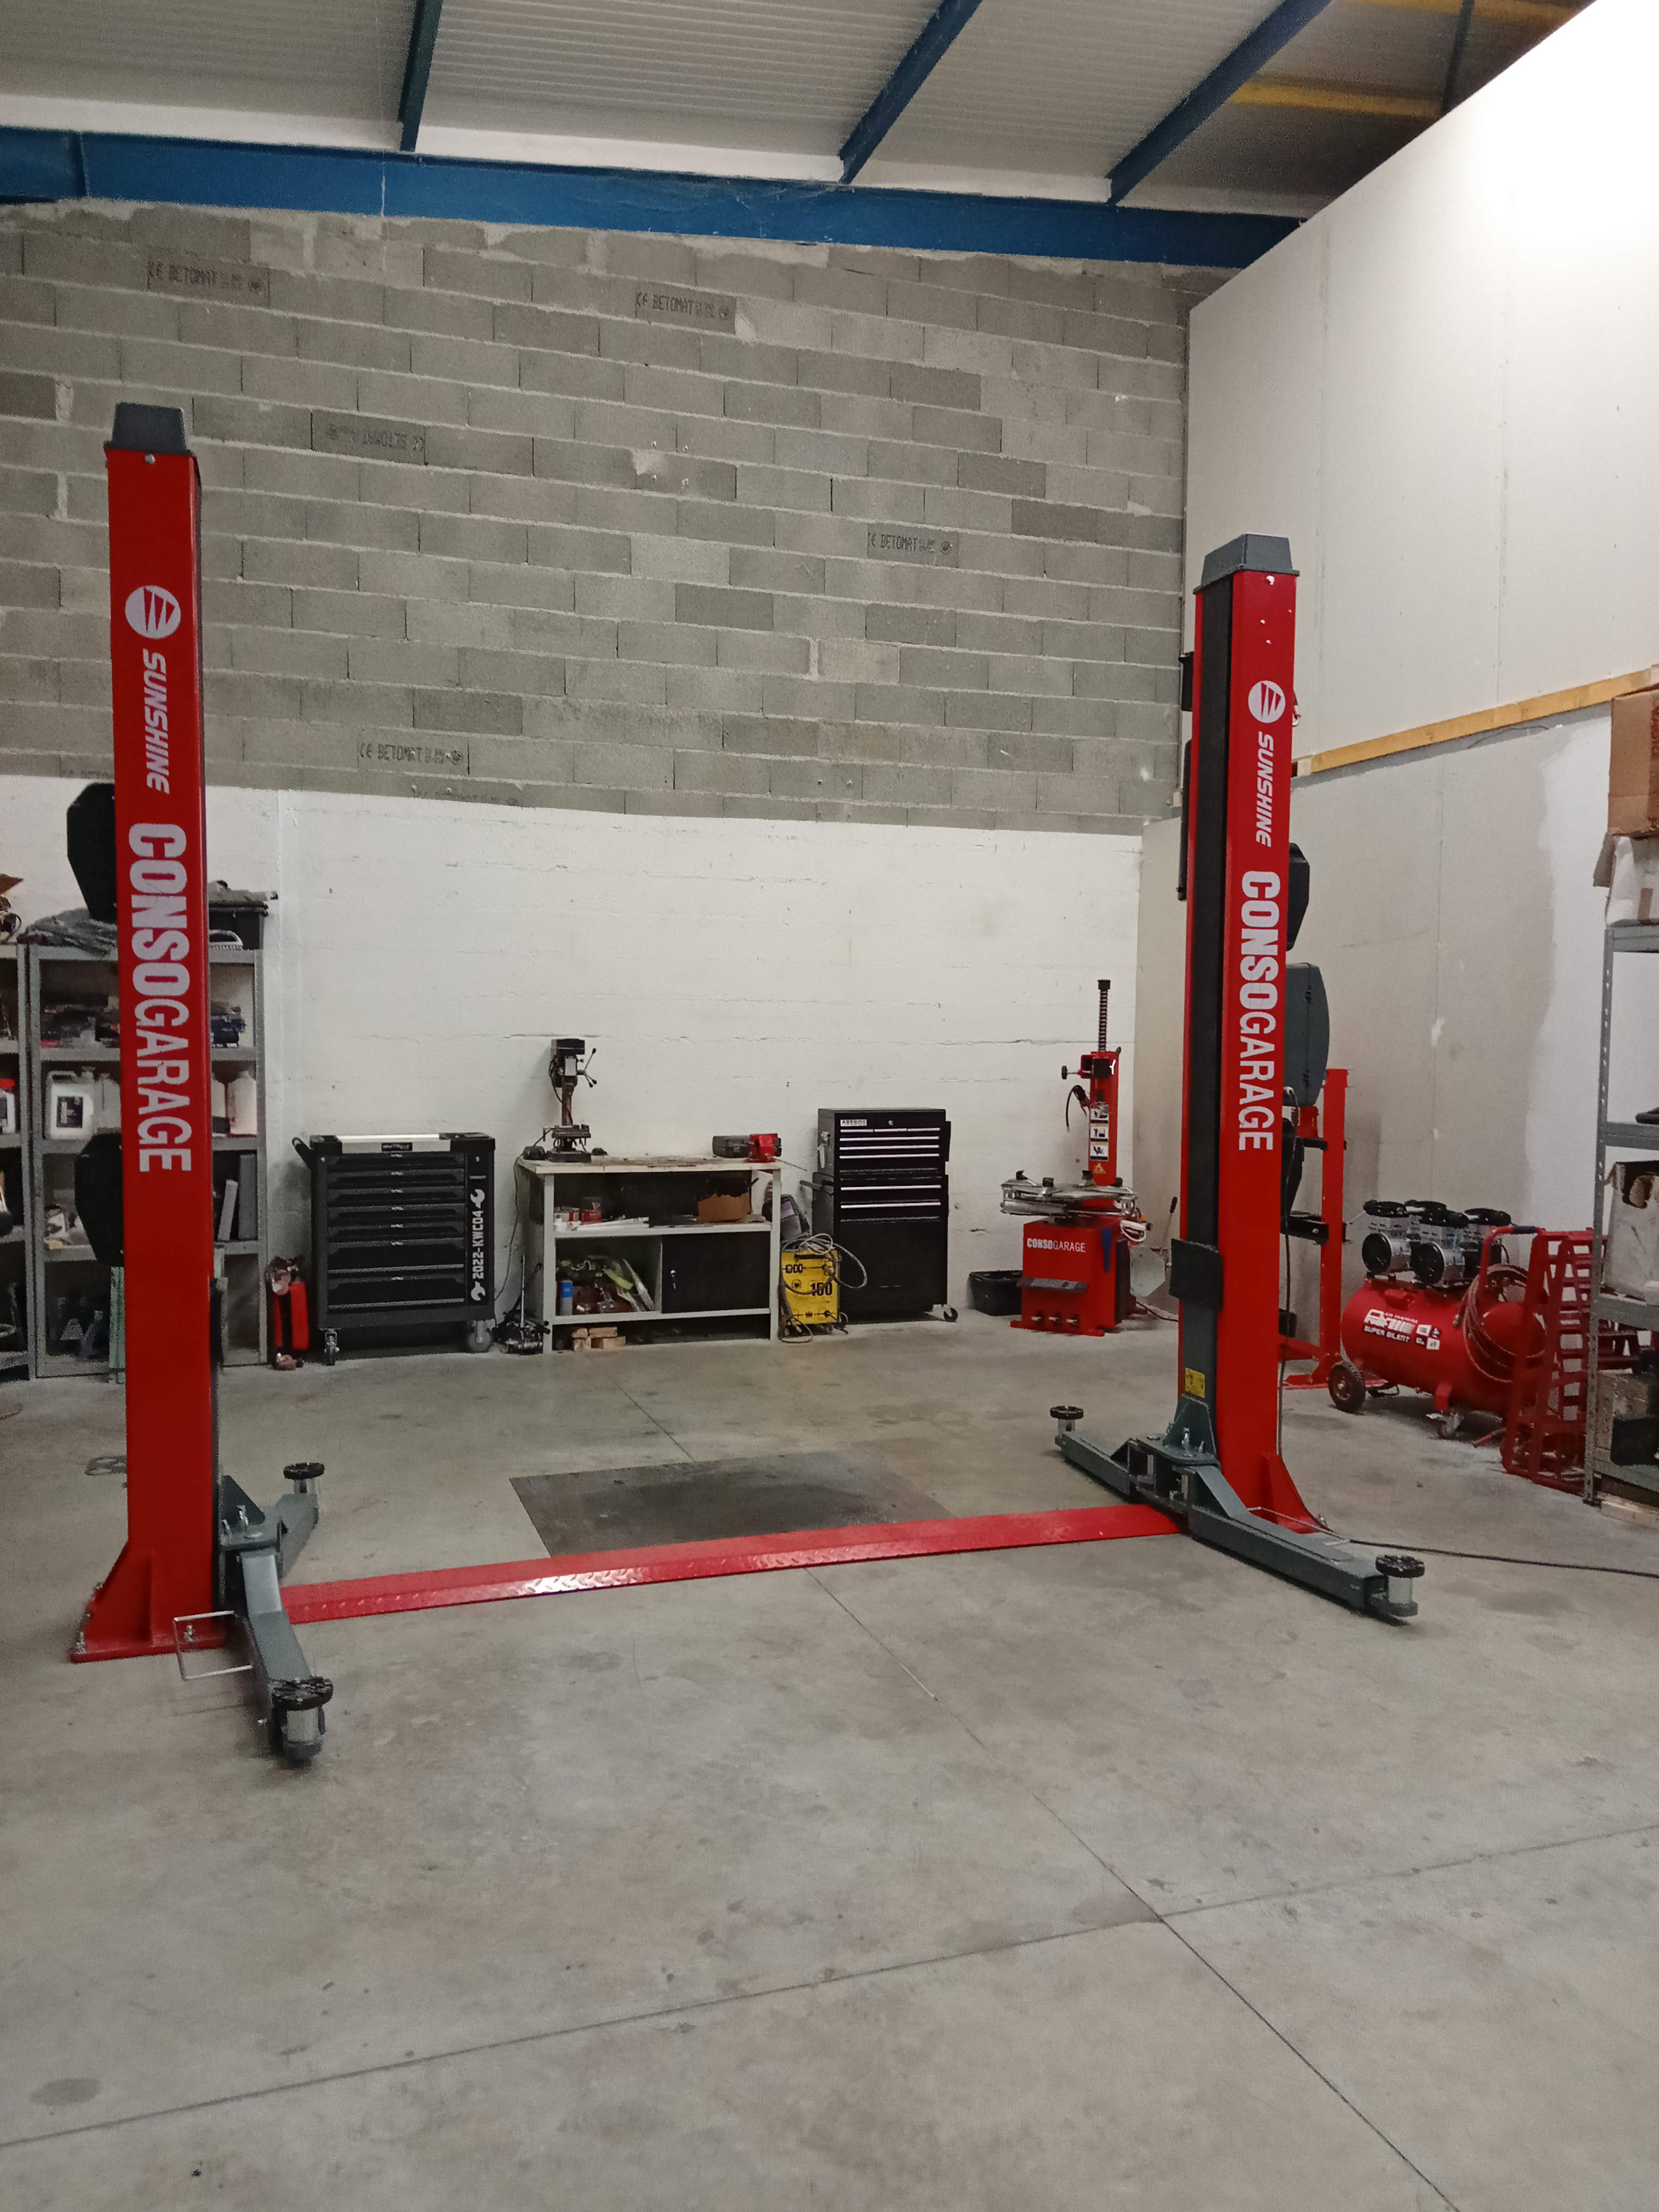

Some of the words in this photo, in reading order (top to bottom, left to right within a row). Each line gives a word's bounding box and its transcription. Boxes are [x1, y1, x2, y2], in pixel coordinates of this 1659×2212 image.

[881, 534, 918, 551] BETOMAT
[143, 648, 170, 795] SUNSHINE
[1256, 731, 1274, 848] SUNSHINE
[129, 823, 192, 1172] CONSOGARAGE
[1238, 870, 1280, 1151] CONSOGARAGE
[1027, 1237, 1086, 1252] CONSOGARAGE
[1364, 1325, 1385, 1336] SUPER
[1386, 1331, 1410, 1343] SILENT
